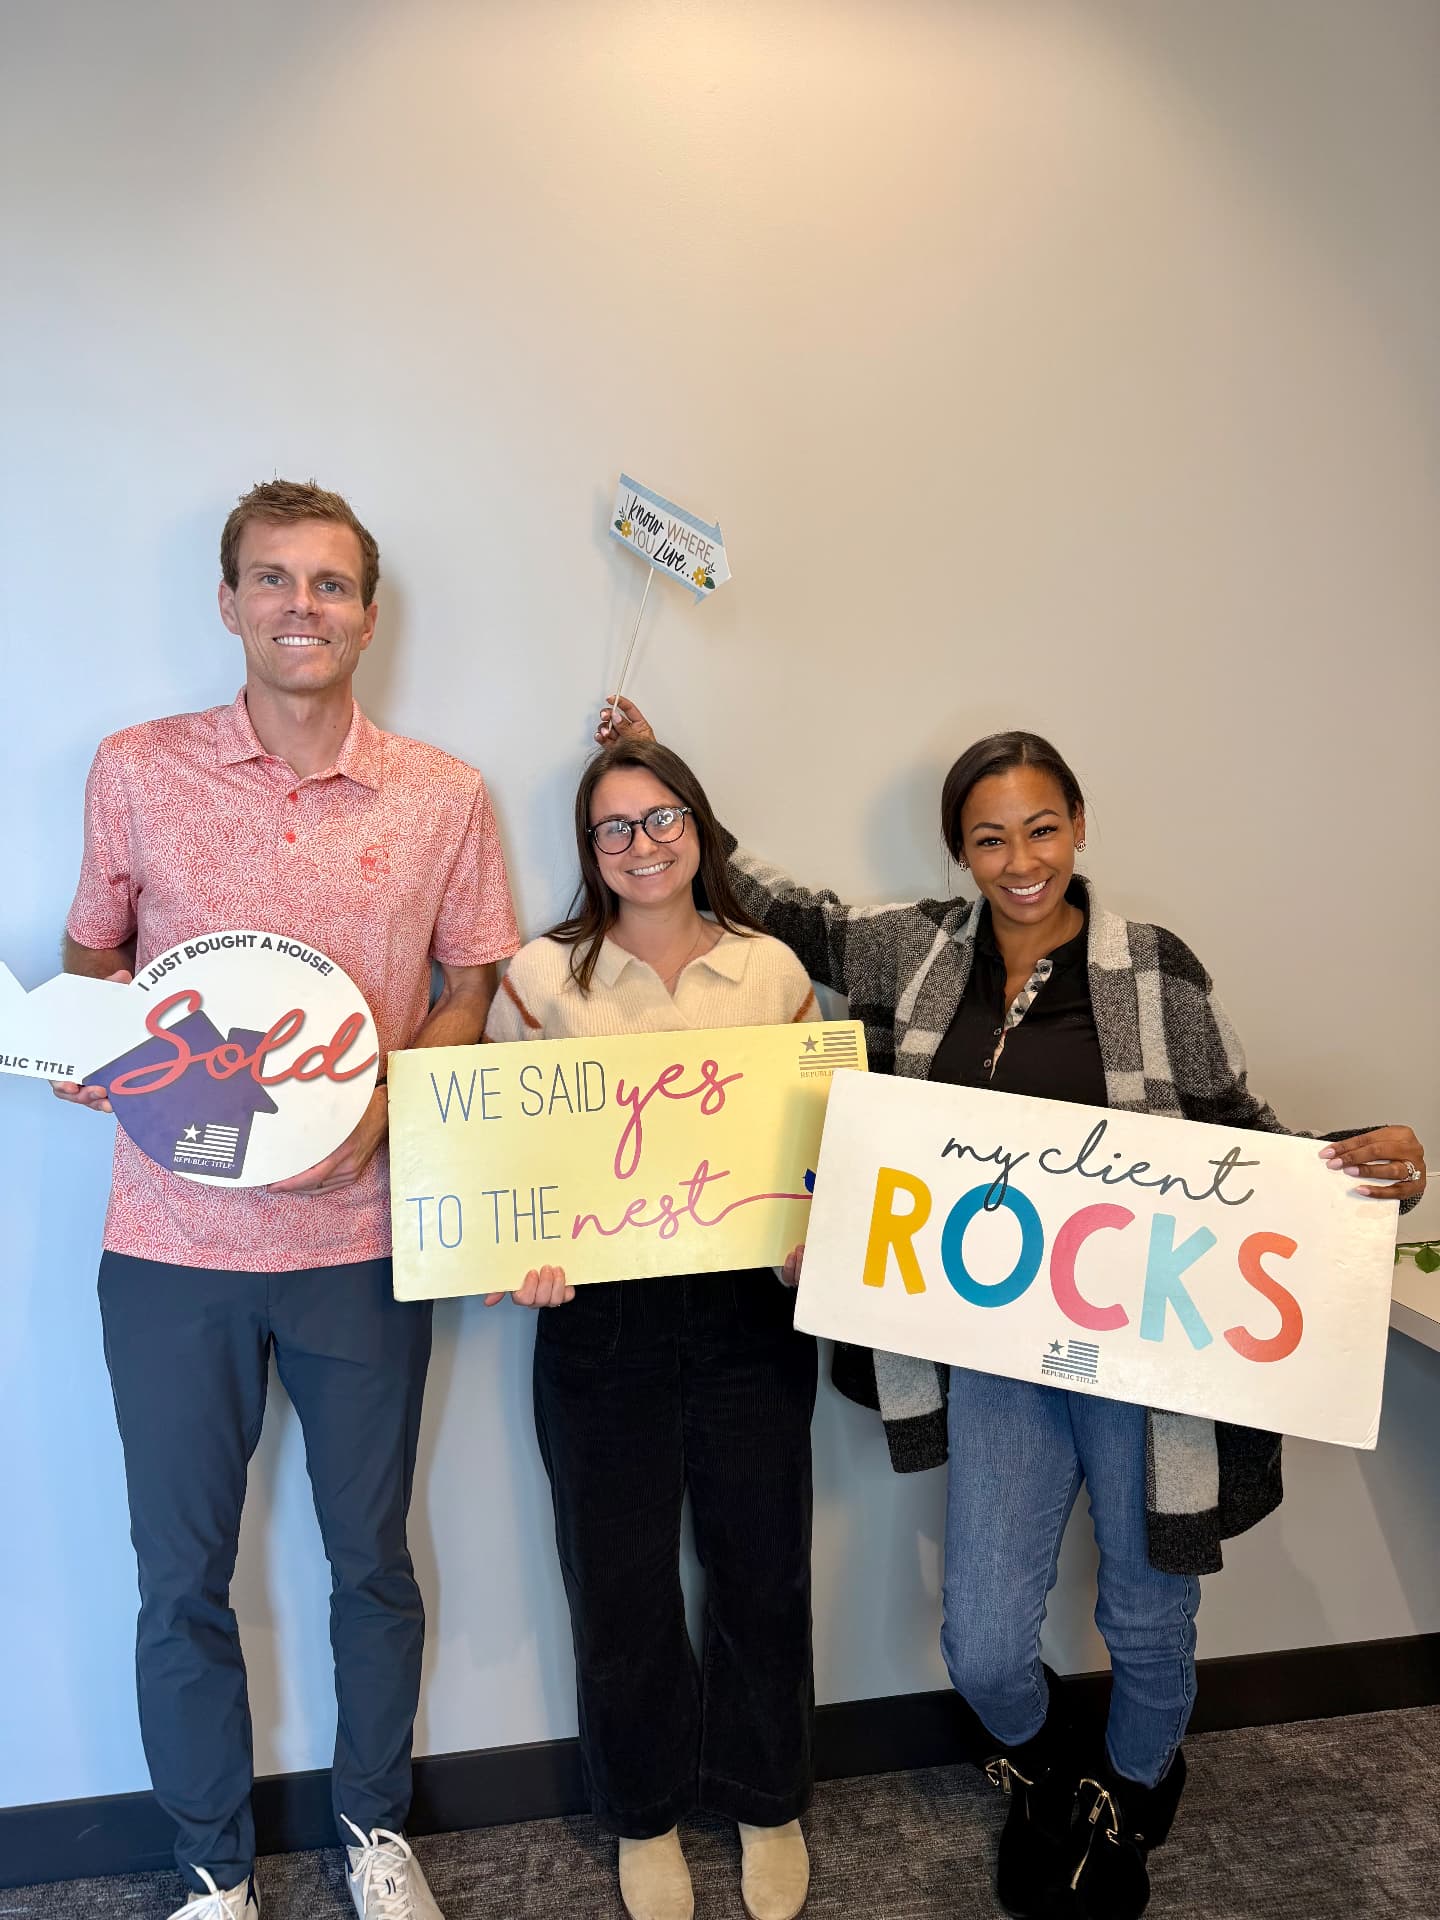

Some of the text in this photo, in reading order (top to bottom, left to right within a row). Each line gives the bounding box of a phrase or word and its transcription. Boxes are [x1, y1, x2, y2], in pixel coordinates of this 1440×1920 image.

[628, 495, 664, 536] know
[667, 520, 714, 564] WHERE
[632, 527, 655, 555] YOU
[137, 934, 335, 992] I JUST BOUGHT A HOUSE!
[35, 1059, 75, 1076] TITLE
[110, 989, 378, 1095] Sold
[800, 1069, 833, 1079] REPUBLI
[430, 1059, 744, 1180] WE SAID yes
[405, 1159, 765, 1251] TO THE nest
[941, 1119, 1261, 1212] my client
[862, 1166, 1304, 1363] ROCKS
